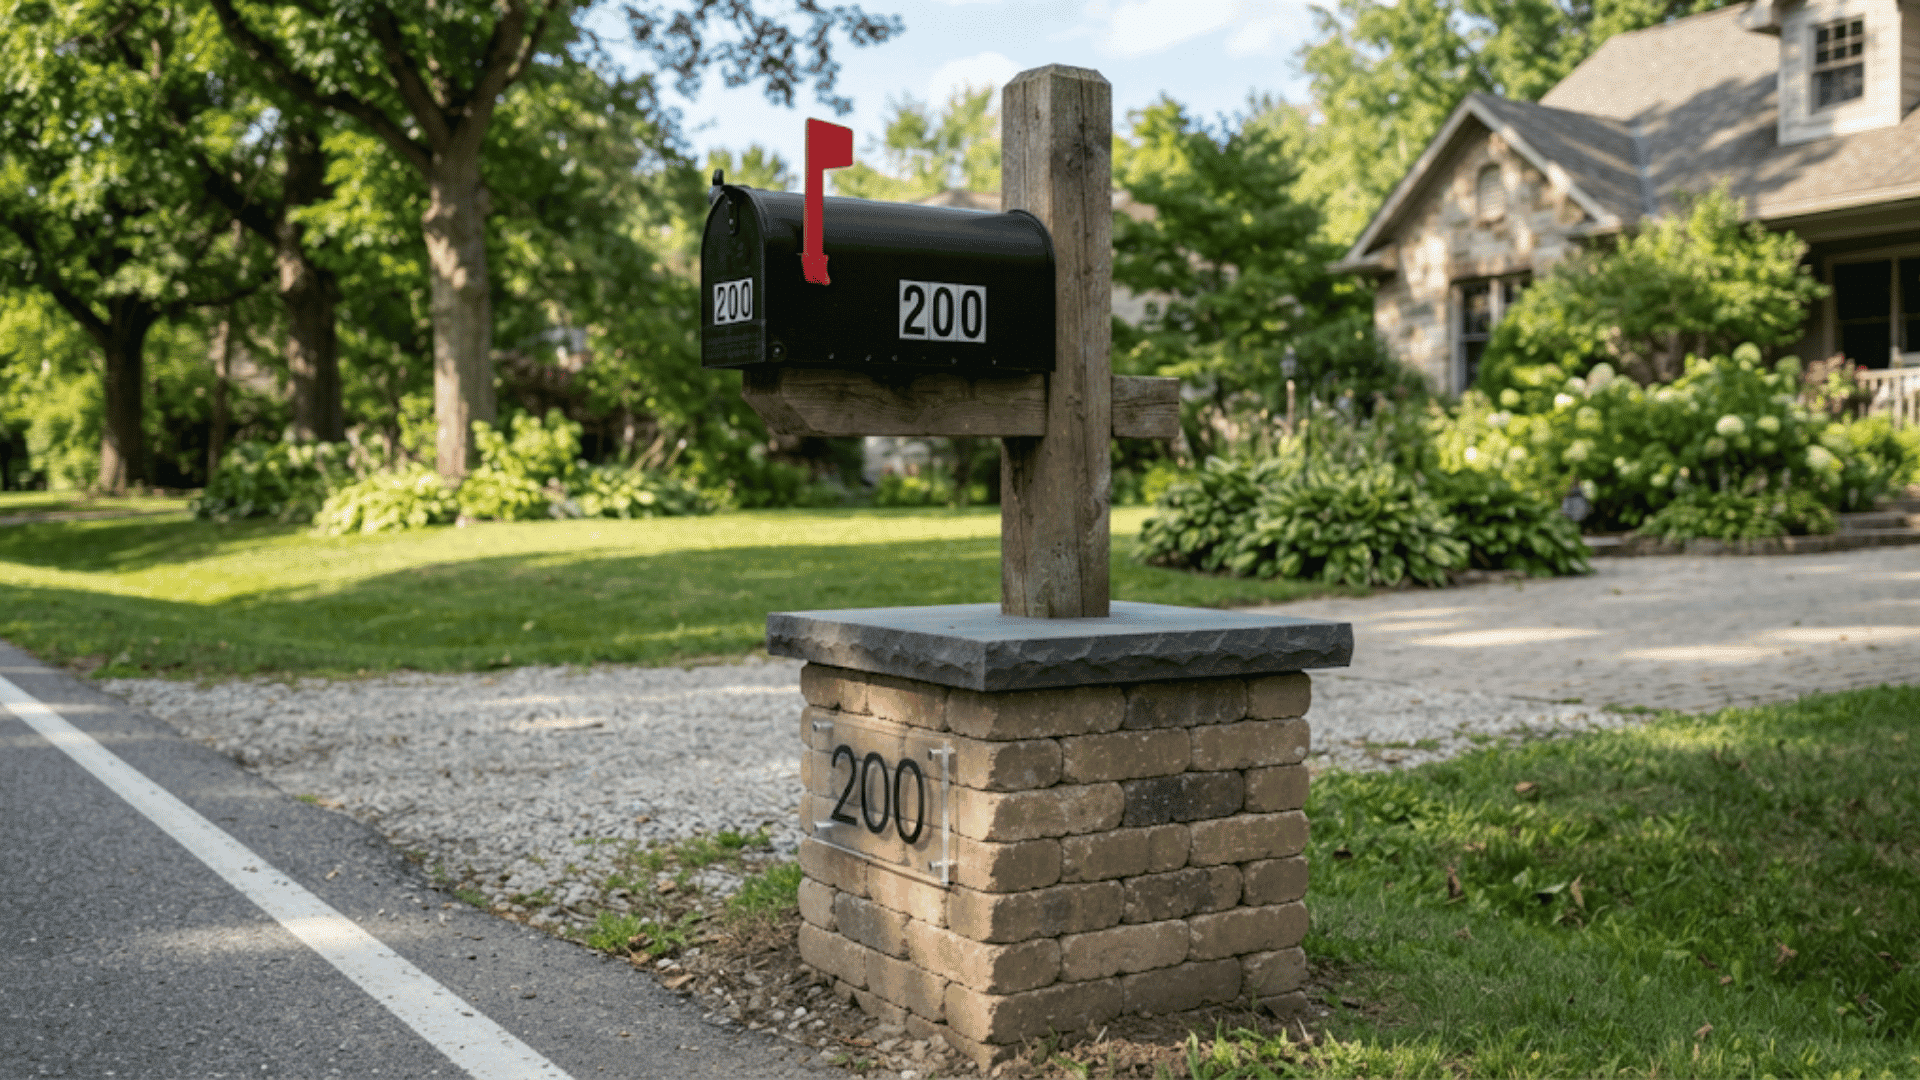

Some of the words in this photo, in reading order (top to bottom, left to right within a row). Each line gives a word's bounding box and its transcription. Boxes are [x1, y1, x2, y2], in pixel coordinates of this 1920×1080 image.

[716, 281, 751, 321] 200
[902, 285, 982, 339] 200
[831, 744, 925, 845] 200
